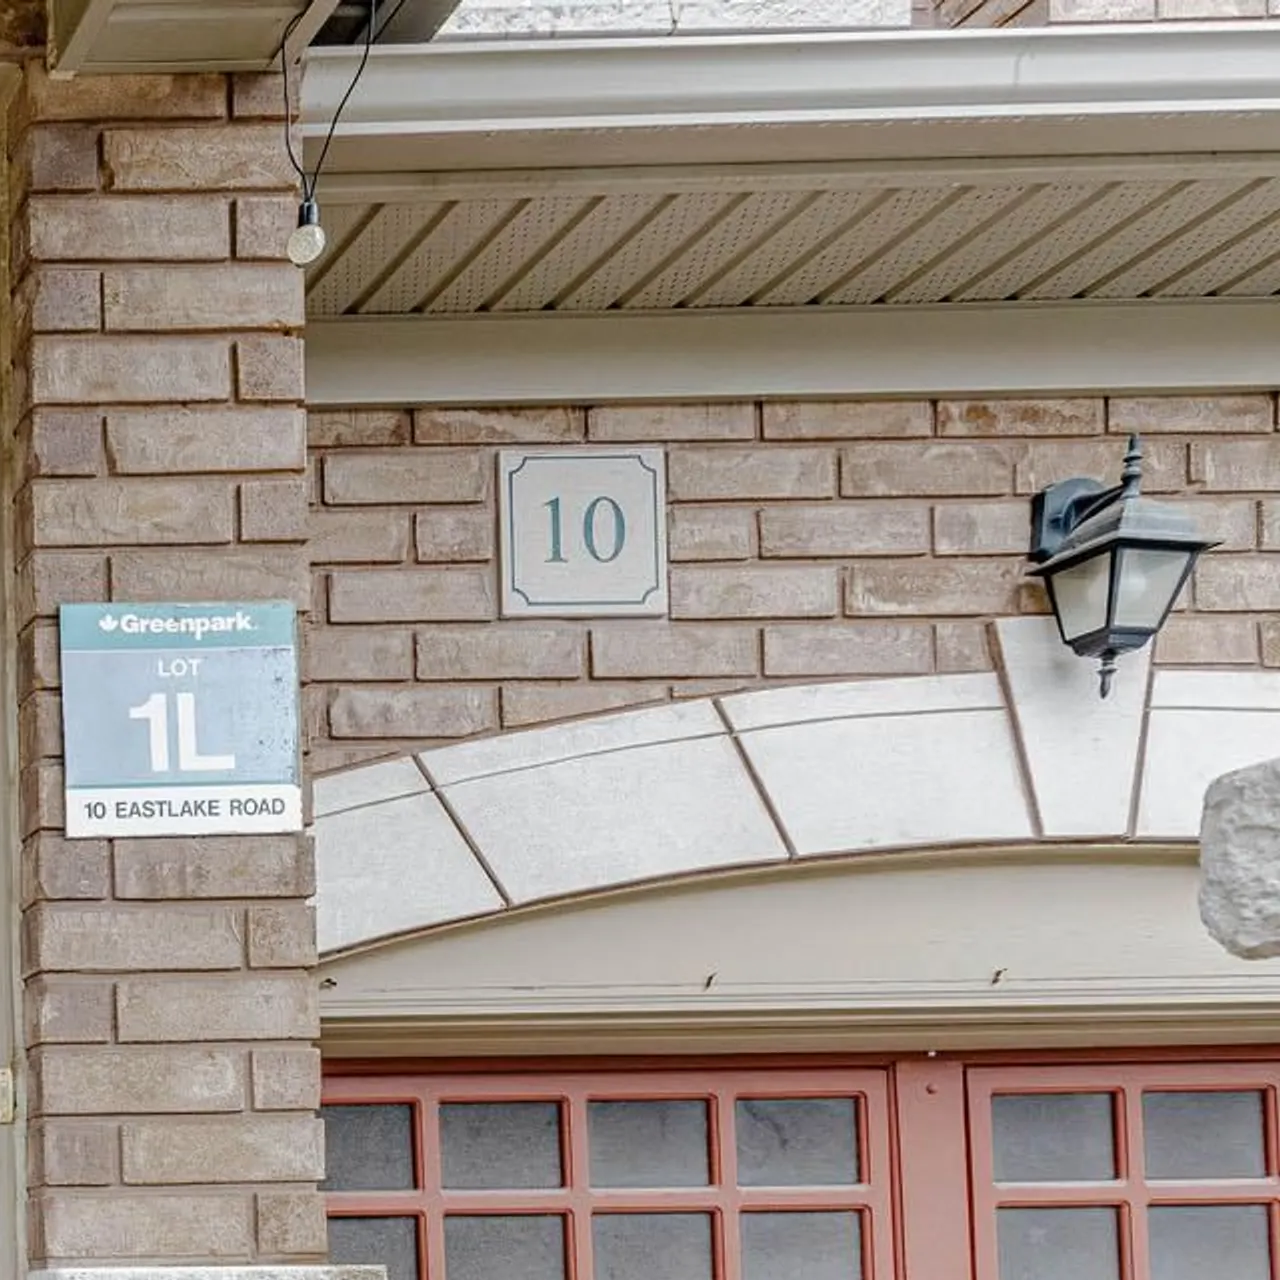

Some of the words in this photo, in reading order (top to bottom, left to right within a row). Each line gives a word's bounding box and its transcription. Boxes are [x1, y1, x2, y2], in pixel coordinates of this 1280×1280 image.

[542, 495, 627, 563] 10
[120, 612, 252, 641] Greenpark
[157, 658, 203, 678] LOT
[128, 692, 236, 773] 1L
[84, 801, 107, 821] 10
[116, 800, 221, 819] EASTLAKE
[230, 798, 286, 817] ROAD
